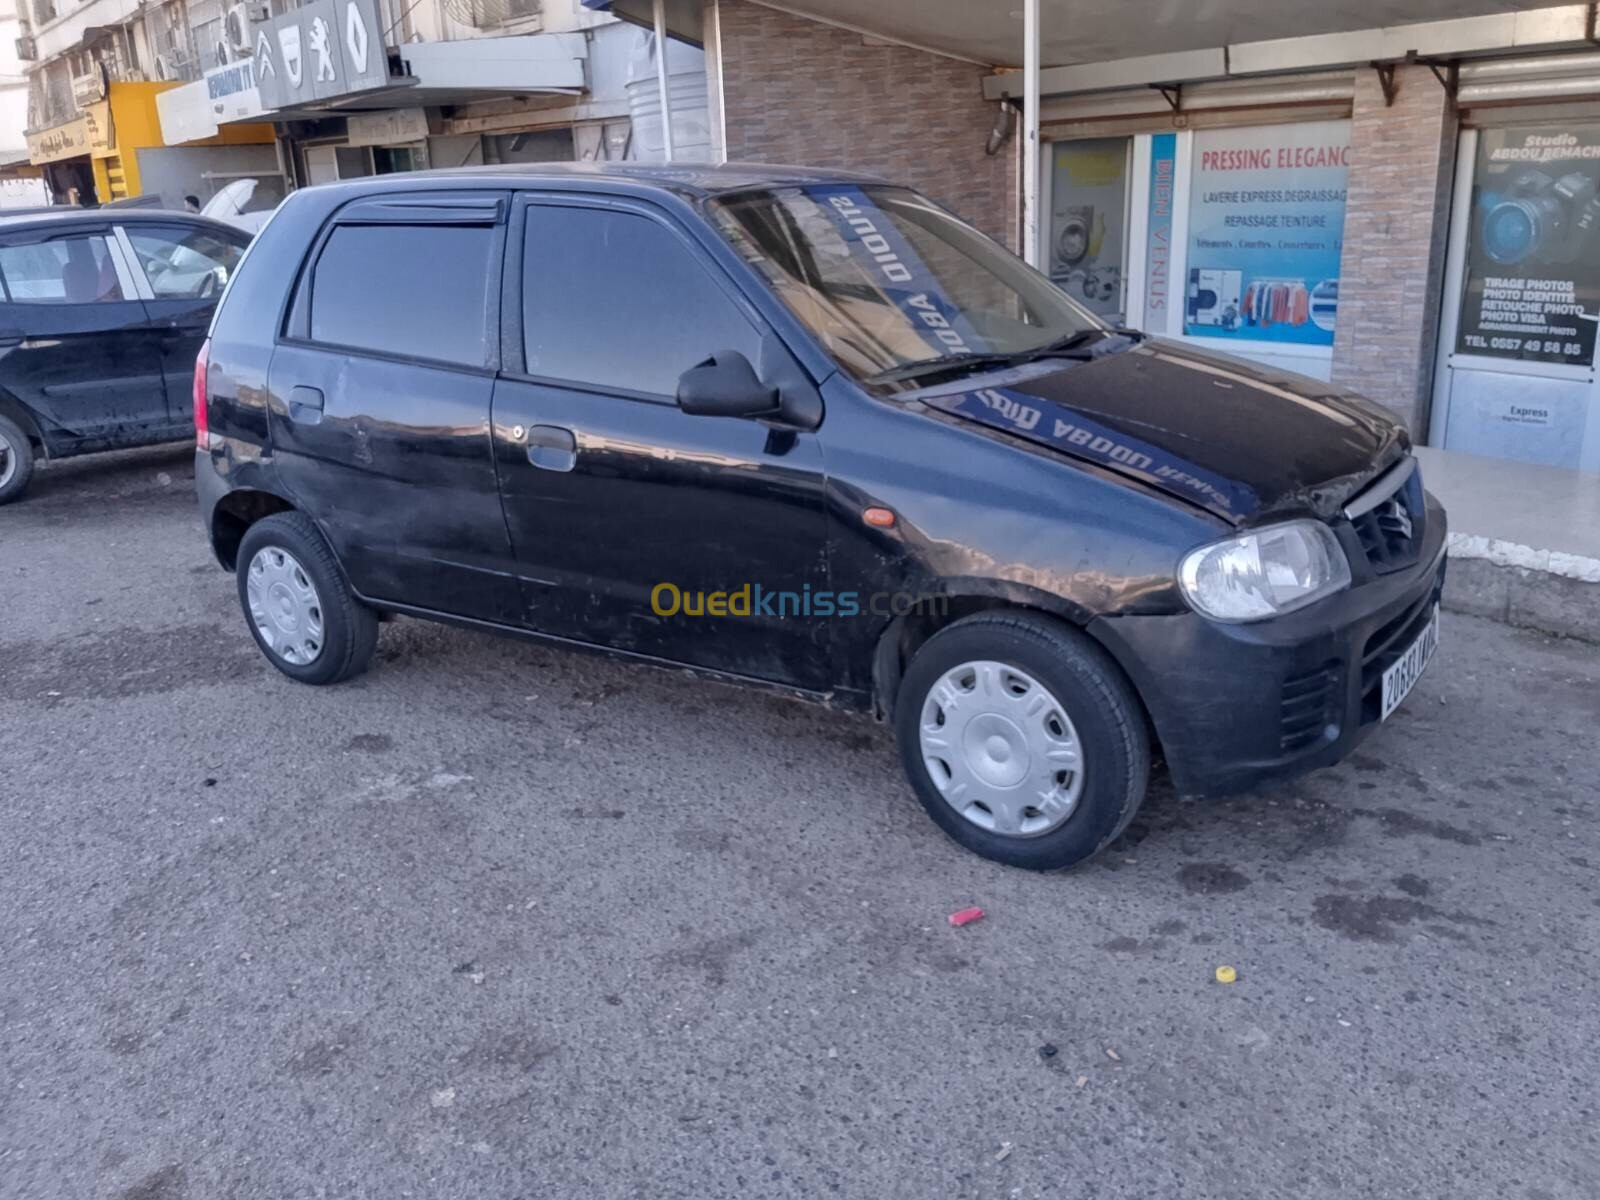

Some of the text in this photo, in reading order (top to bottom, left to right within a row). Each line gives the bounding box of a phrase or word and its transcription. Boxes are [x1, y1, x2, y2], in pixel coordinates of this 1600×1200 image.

[1525, 133, 1577, 147] Studio
[1202, 149, 1272, 171] PRESSING
[1490, 147, 1540, 160] ABDOU
[1203, 191, 1239, 203] LAVERIE
[1150, 160, 1172, 311] BIEN VENUS
[1485, 277, 1574, 292] TIRAGE PHOTOS
[1483, 288, 1521, 300] PHOTO
[1482, 299, 1542, 313] RETOUCHE
[1480, 310, 1546, 325] PHOTO VISA
[1549, 326, 1577, 336] PHOTO
[1465, 335, 1488, 348] TEL
[1490, 337, 1522, 350] 0557
[1524, 339, 1541, 352] 49
[1563, 342, 1582, 356] 85
[1510, 405, 1548, 418] Express
